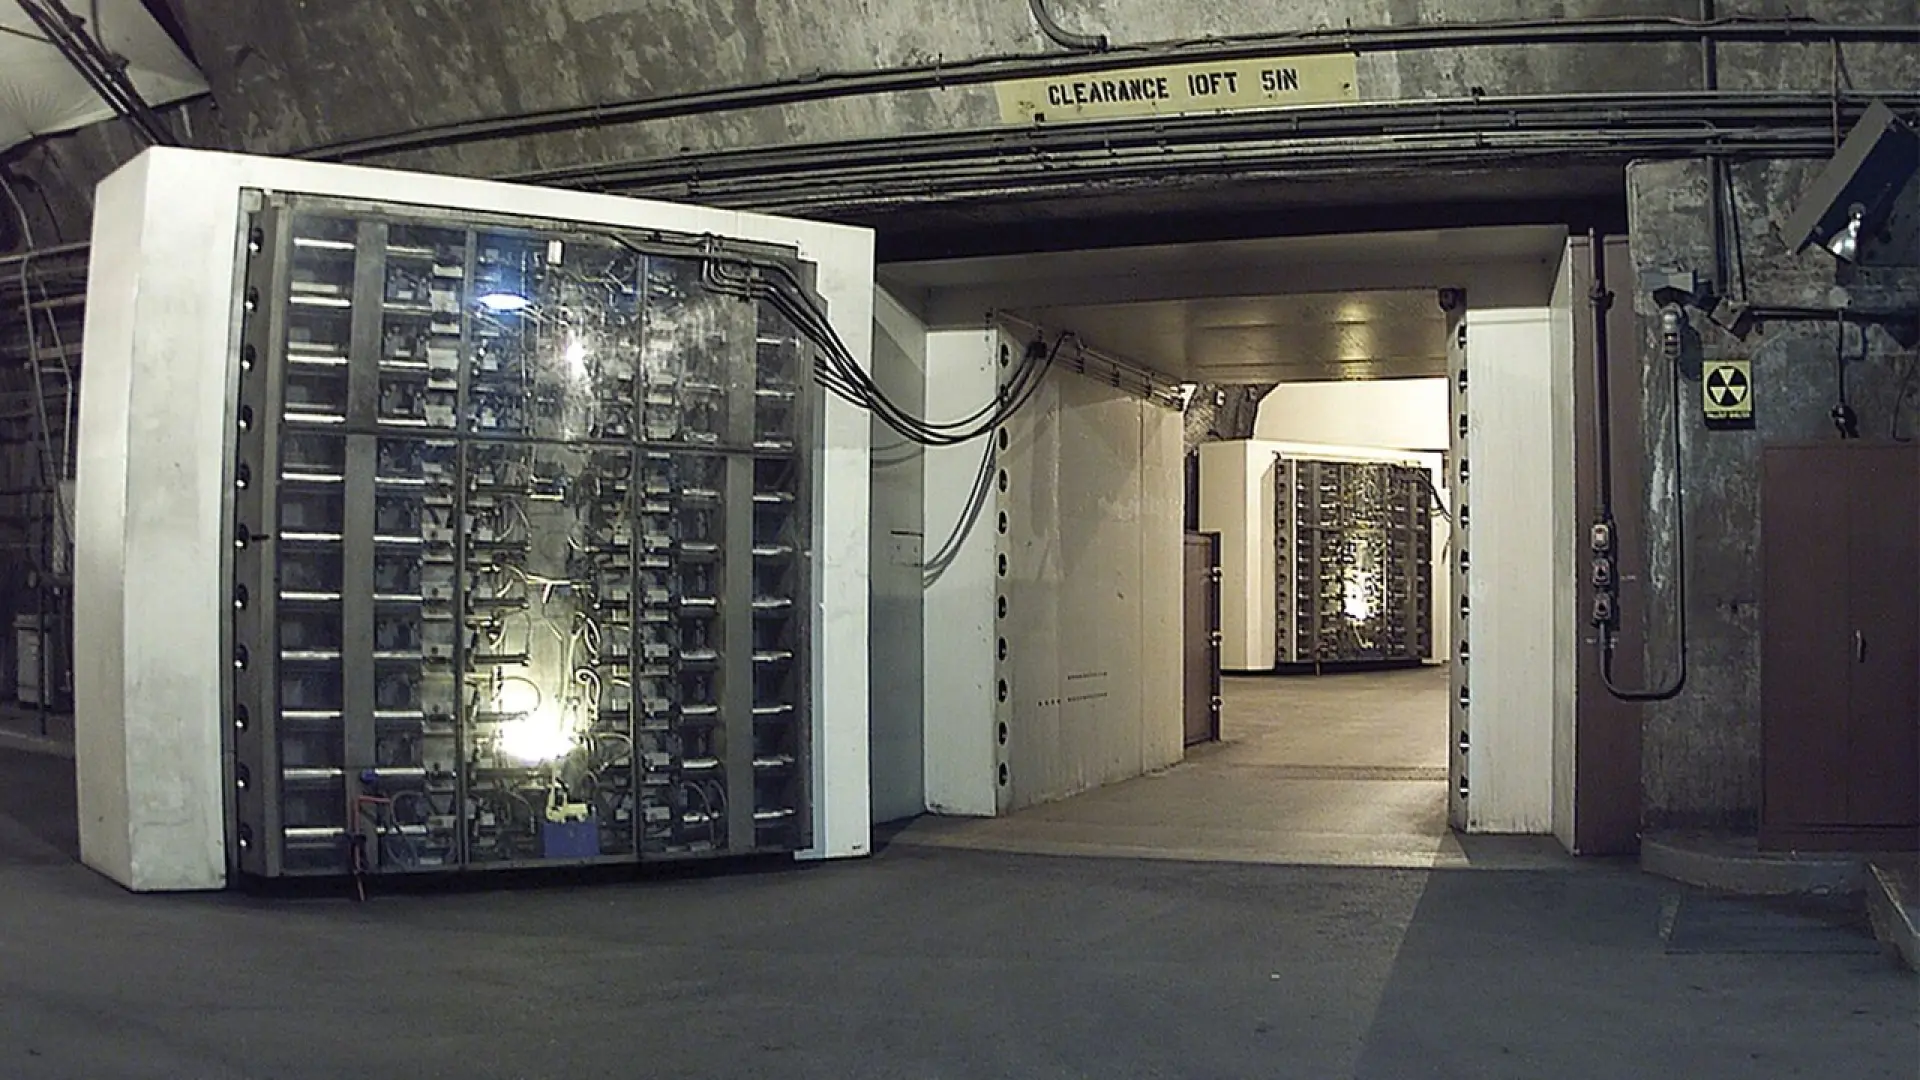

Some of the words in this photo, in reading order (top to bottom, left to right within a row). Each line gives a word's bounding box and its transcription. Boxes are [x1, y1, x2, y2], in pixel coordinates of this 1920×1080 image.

[1048, 77, 1169, 106] CLEARANCE
[1187, 71, 1237, 97] 10FT
[1261, 68, 1299, 91] 5IN
